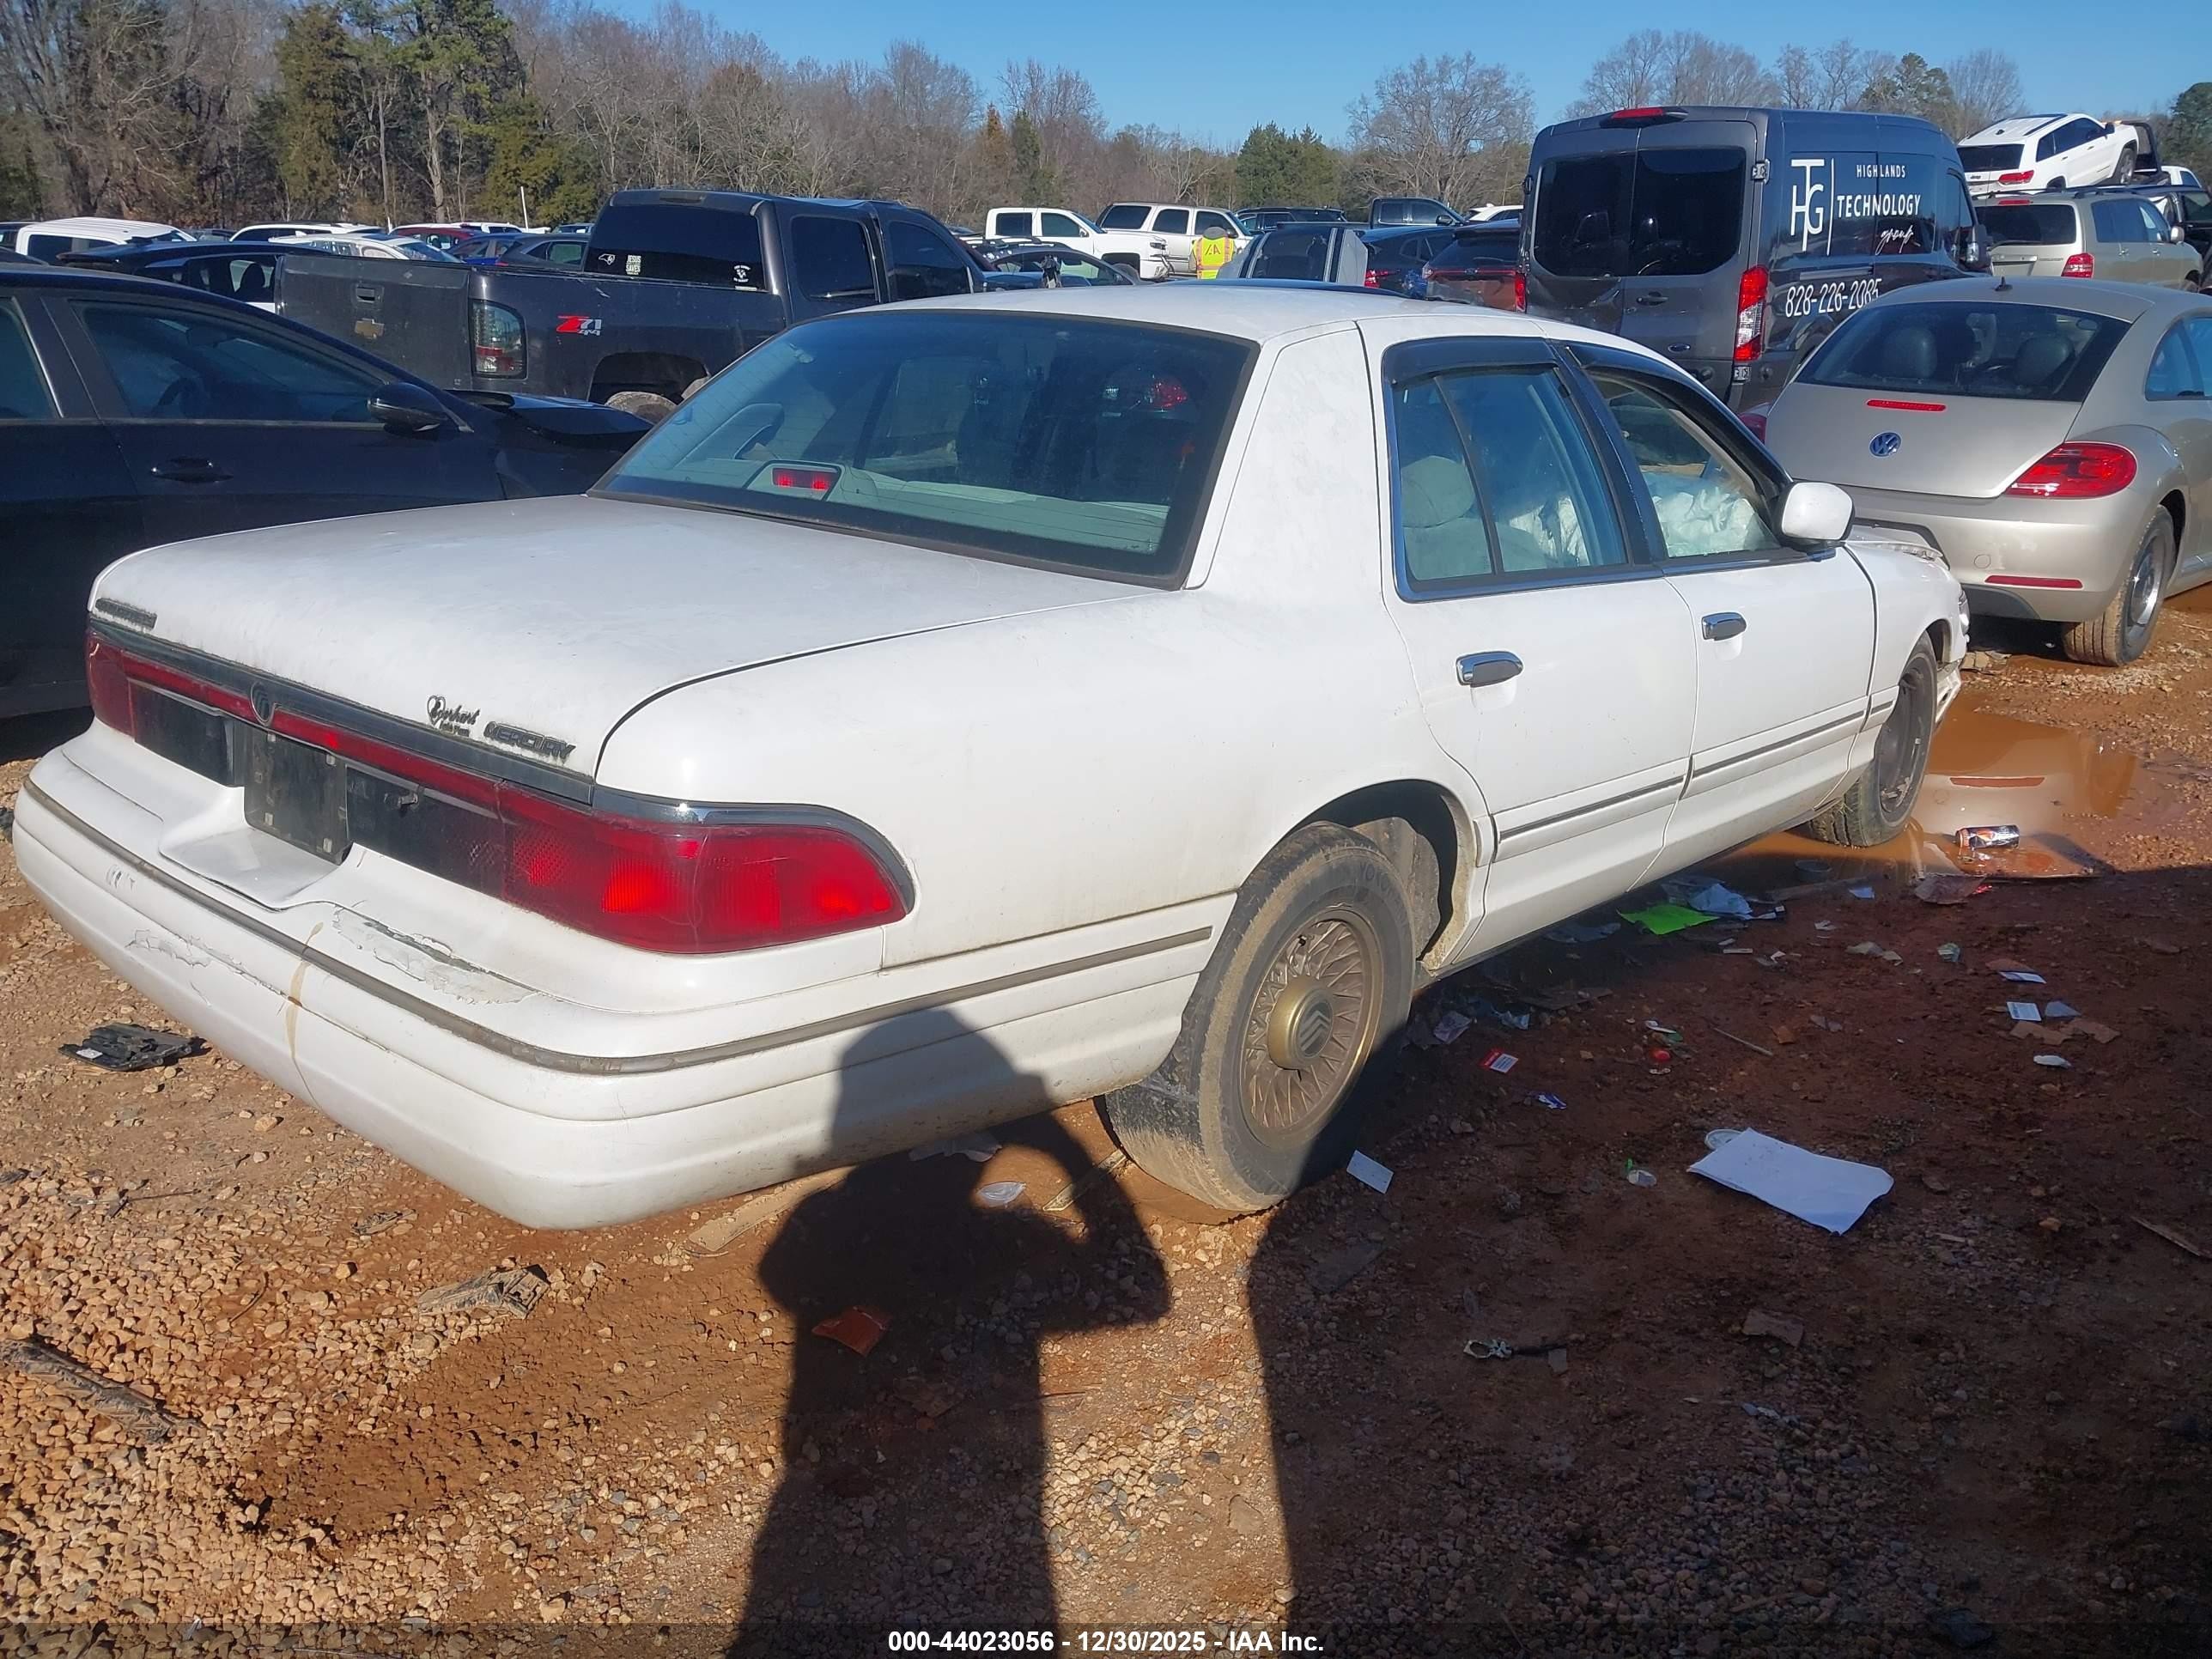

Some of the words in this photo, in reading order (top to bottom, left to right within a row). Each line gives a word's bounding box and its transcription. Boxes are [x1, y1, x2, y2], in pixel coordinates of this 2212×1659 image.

[1856, 164, 1906, 178] HIGHLANDS
[1837, 194, 1921, 217] TECHNOLOGY
[1785, 278, 1882, 318] 828-226-2085
[556, 315, 602, 332] Z71
[483, 721, 576, 760] MERCURY
